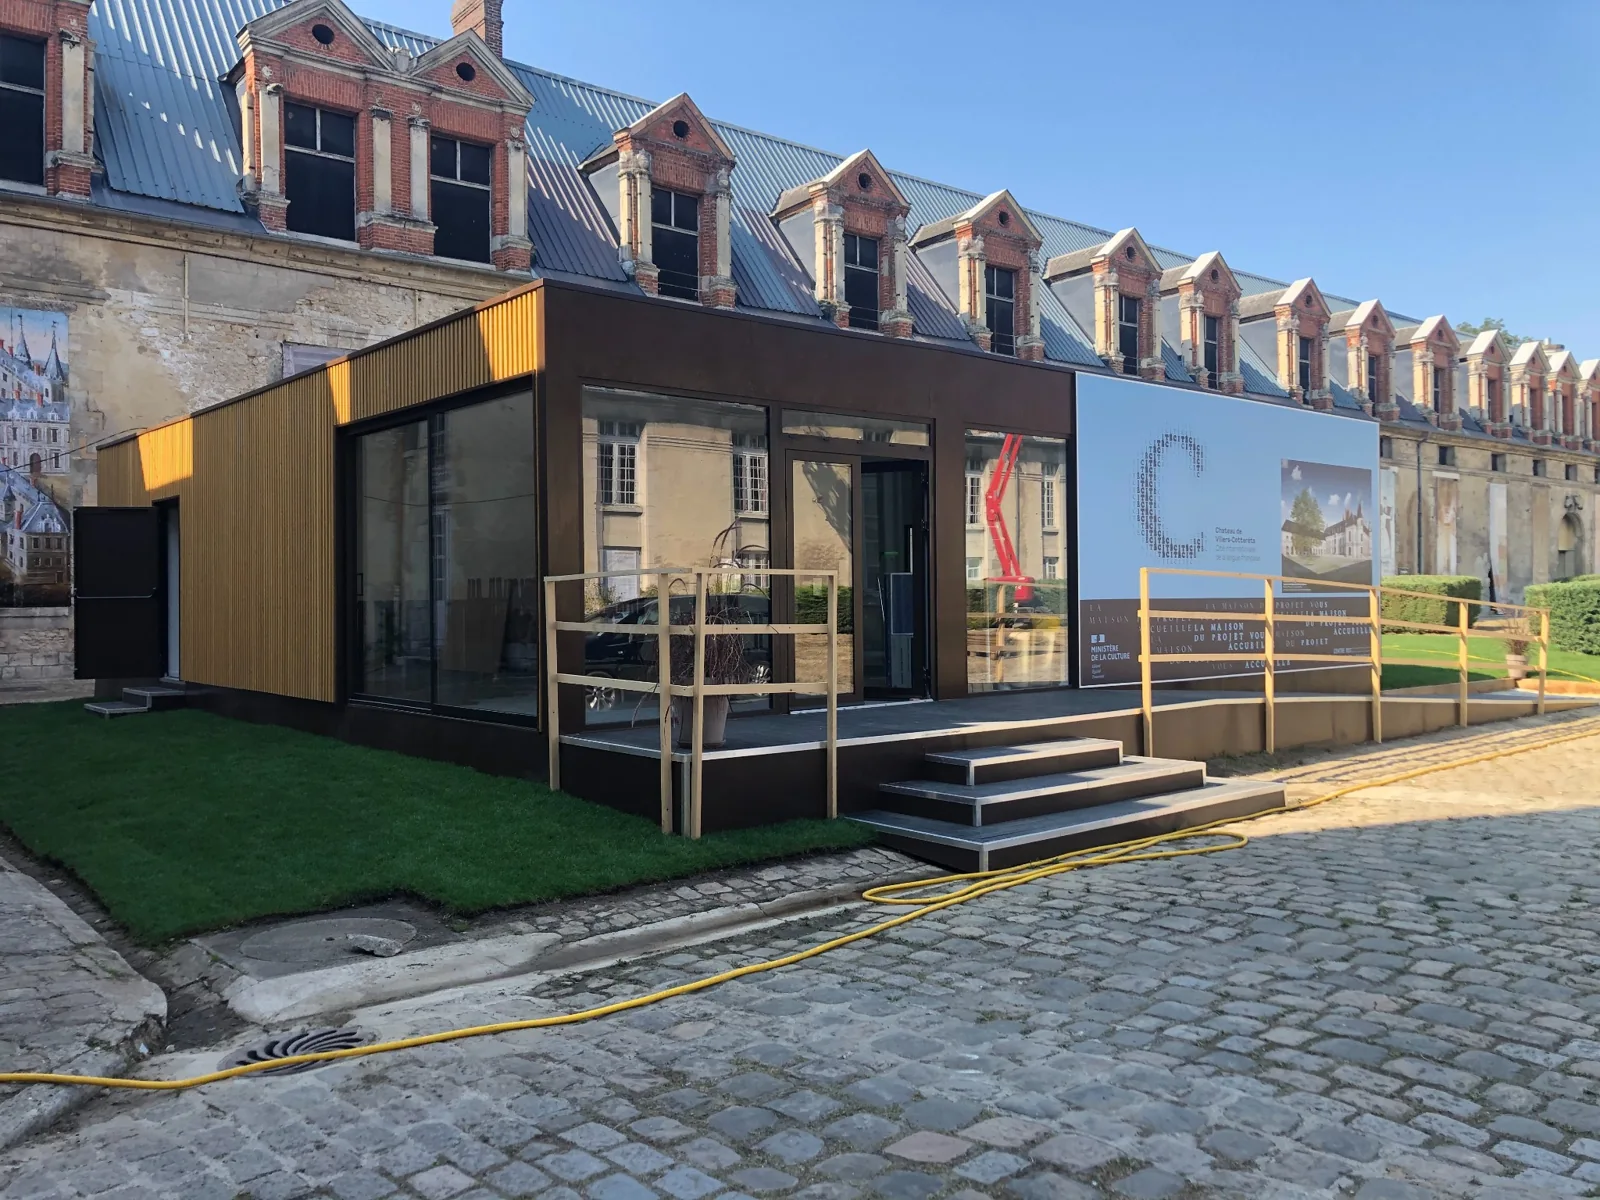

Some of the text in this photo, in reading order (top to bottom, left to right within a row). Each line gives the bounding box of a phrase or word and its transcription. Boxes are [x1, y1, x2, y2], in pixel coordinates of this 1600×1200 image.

[1194, 622, 1244, 632] LA MAISON
[1193, 631, 1265, 642] DU PROJET VOU
[1300, 638, 1329, 646] PROJET
[1090, 644, 1119, 653] MINISTÈRE
[1099, 653, 1107, 661] LA
[1107, 652, 1130, 660] CULTURE
